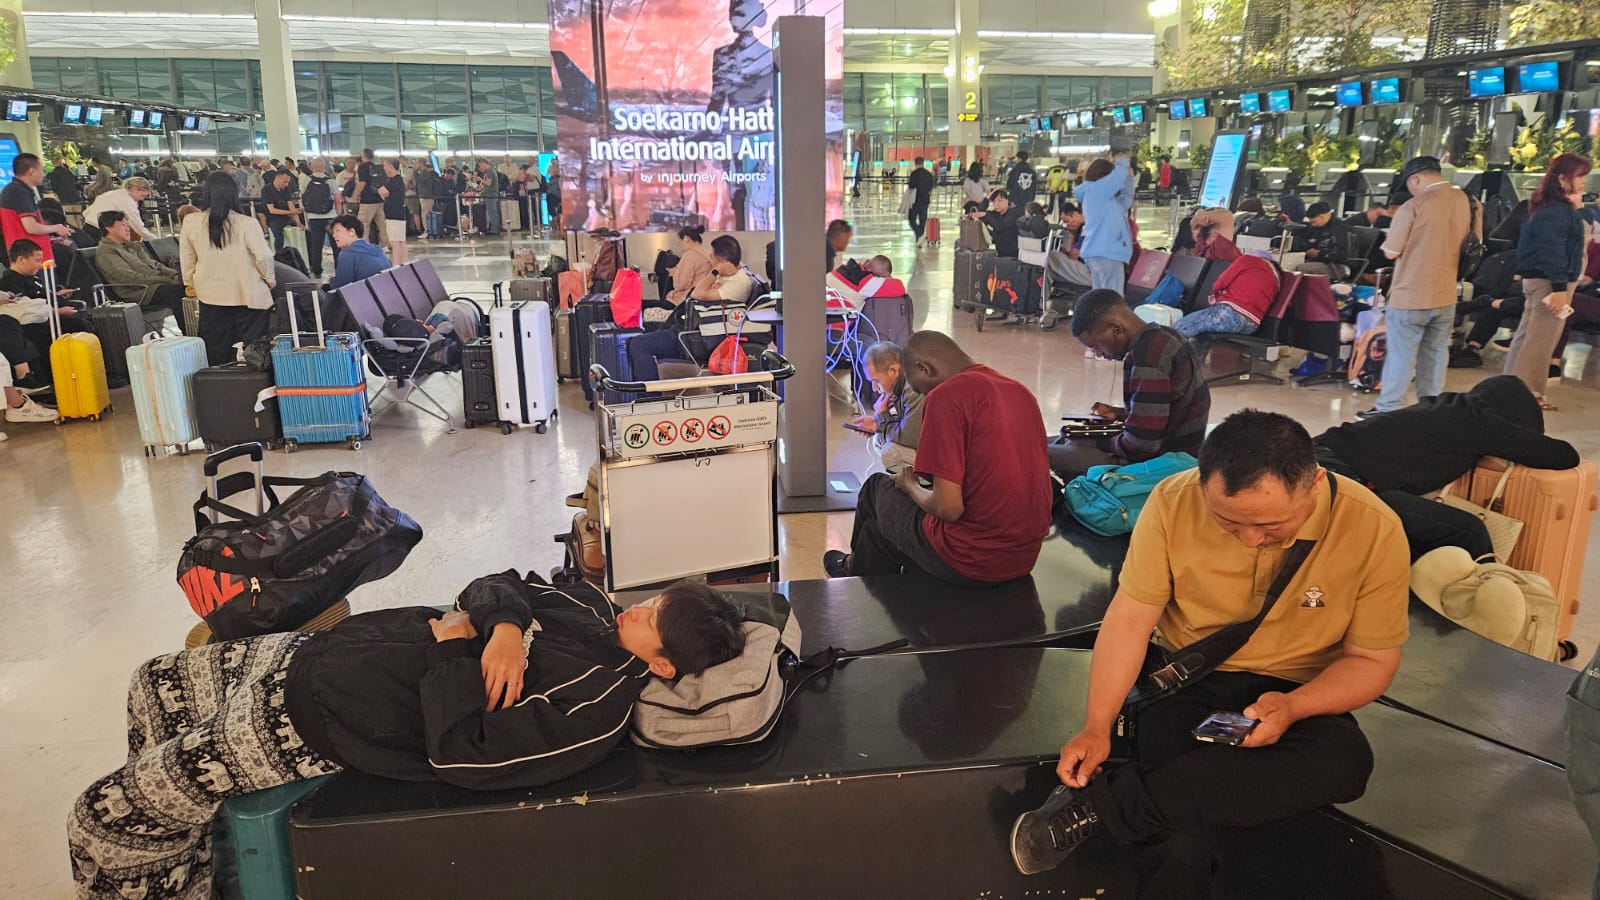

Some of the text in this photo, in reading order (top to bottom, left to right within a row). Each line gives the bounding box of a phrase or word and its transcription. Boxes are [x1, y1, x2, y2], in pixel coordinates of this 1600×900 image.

[965, 91, 977, 110] 2
[613, 104, 774, 131] Soekarno-Hatt
[590, 134, 732, 161] International
[640, 172, 653, 184] by
[720, 172, 767, 184] Airports
